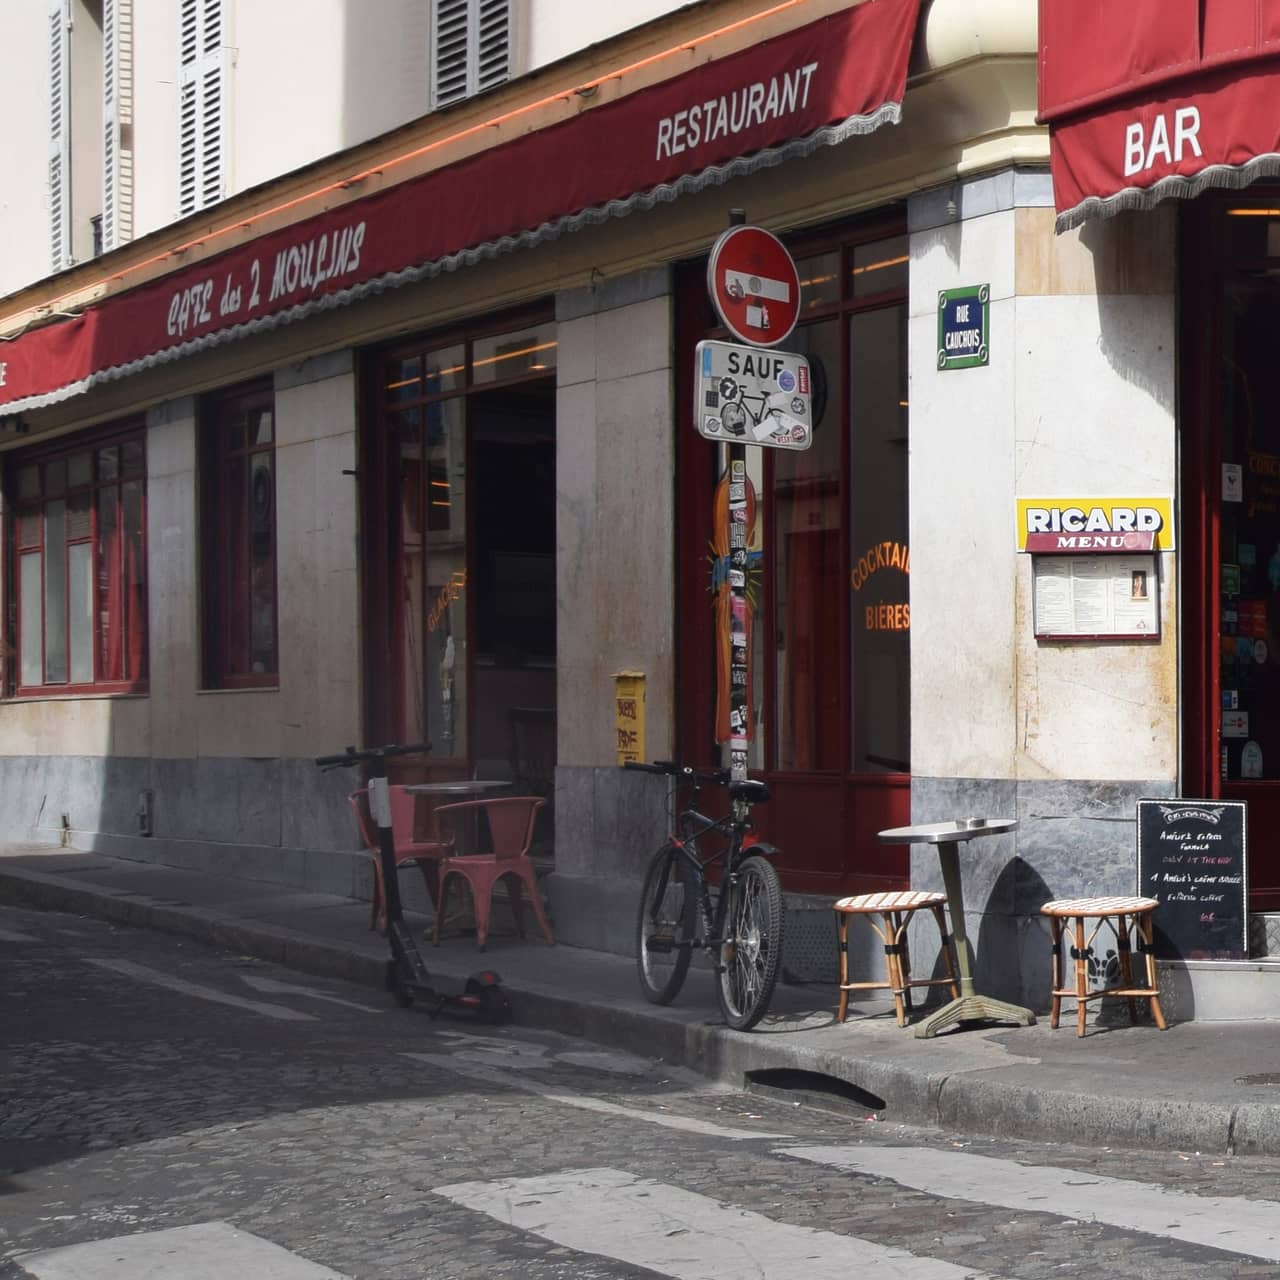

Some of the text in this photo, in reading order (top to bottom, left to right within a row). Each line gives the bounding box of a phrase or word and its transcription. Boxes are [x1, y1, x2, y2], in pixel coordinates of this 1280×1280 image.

[656, 62, 818, 160] RESTAURANT
[1124, 106, 1202, 177] BAR
[220, 272, 242, 316] des
[248, 259, 260, 310] 2
[269, 221, 366, 292] MOULINS
[956, 304, 970, 323] RUE
[945, 329, 980, 350] CAUCHOIS
[728, 352, 785, 380] SAUF
[1026, 508, 1163, 533] RICARD
[1057, 536, 1125, 548] MENU
